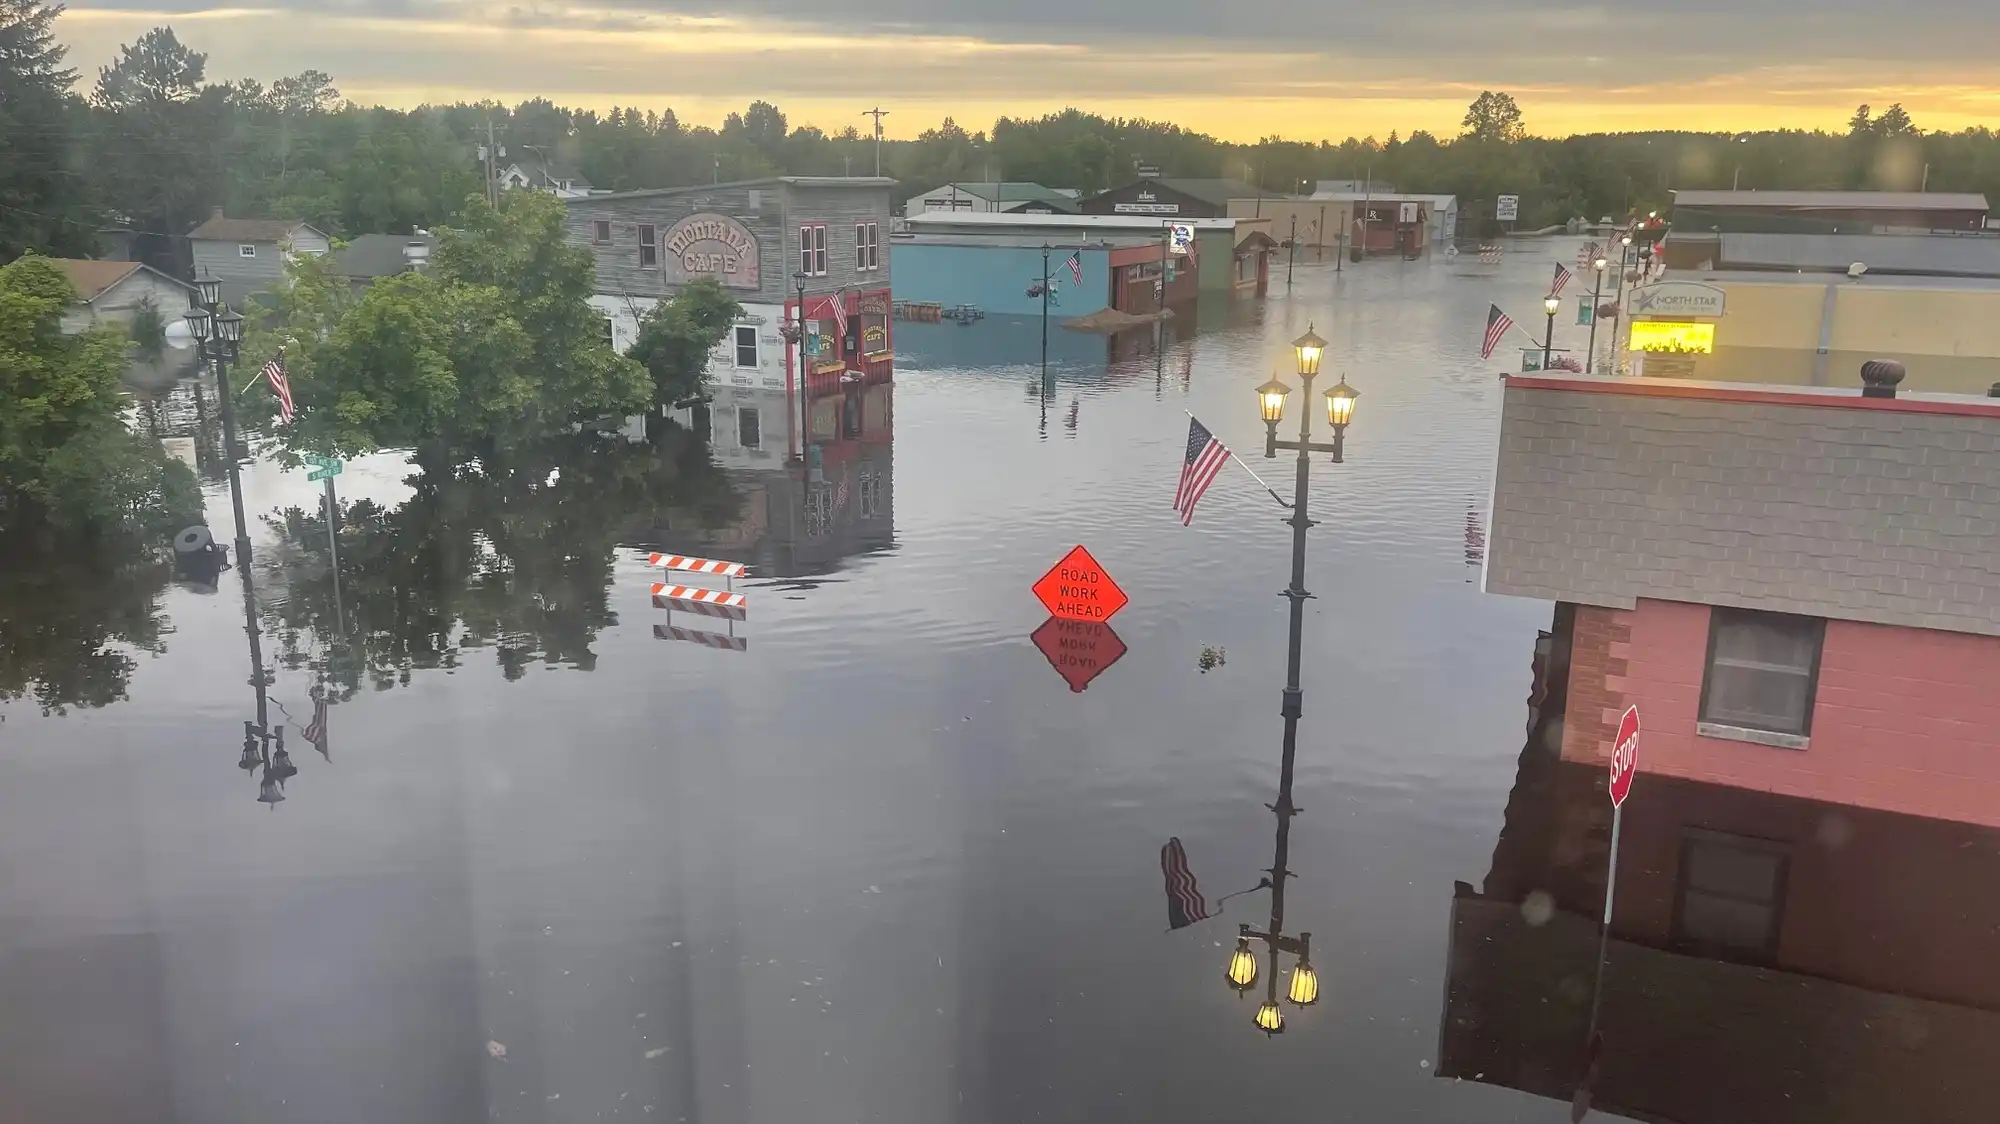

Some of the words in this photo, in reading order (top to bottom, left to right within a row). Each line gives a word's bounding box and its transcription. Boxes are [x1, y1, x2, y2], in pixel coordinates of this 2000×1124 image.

[667, 220, 752, 258] MONTANA
[683, 252, 737, 273] CAFE
[1656, 295, 1691, 305] NORTH
[1694, 296, 1717, 306] STAR
[867, 333, 881, 341] CAFE
[819, 342, 830, 350] AFE
[1060, 568, 1099, 583] ROAD
[1059, 585, 1099, 600] WORK
[1056, 602, 1103, 617] AHEAD
[1612, 731, 1637, 784] STOP
